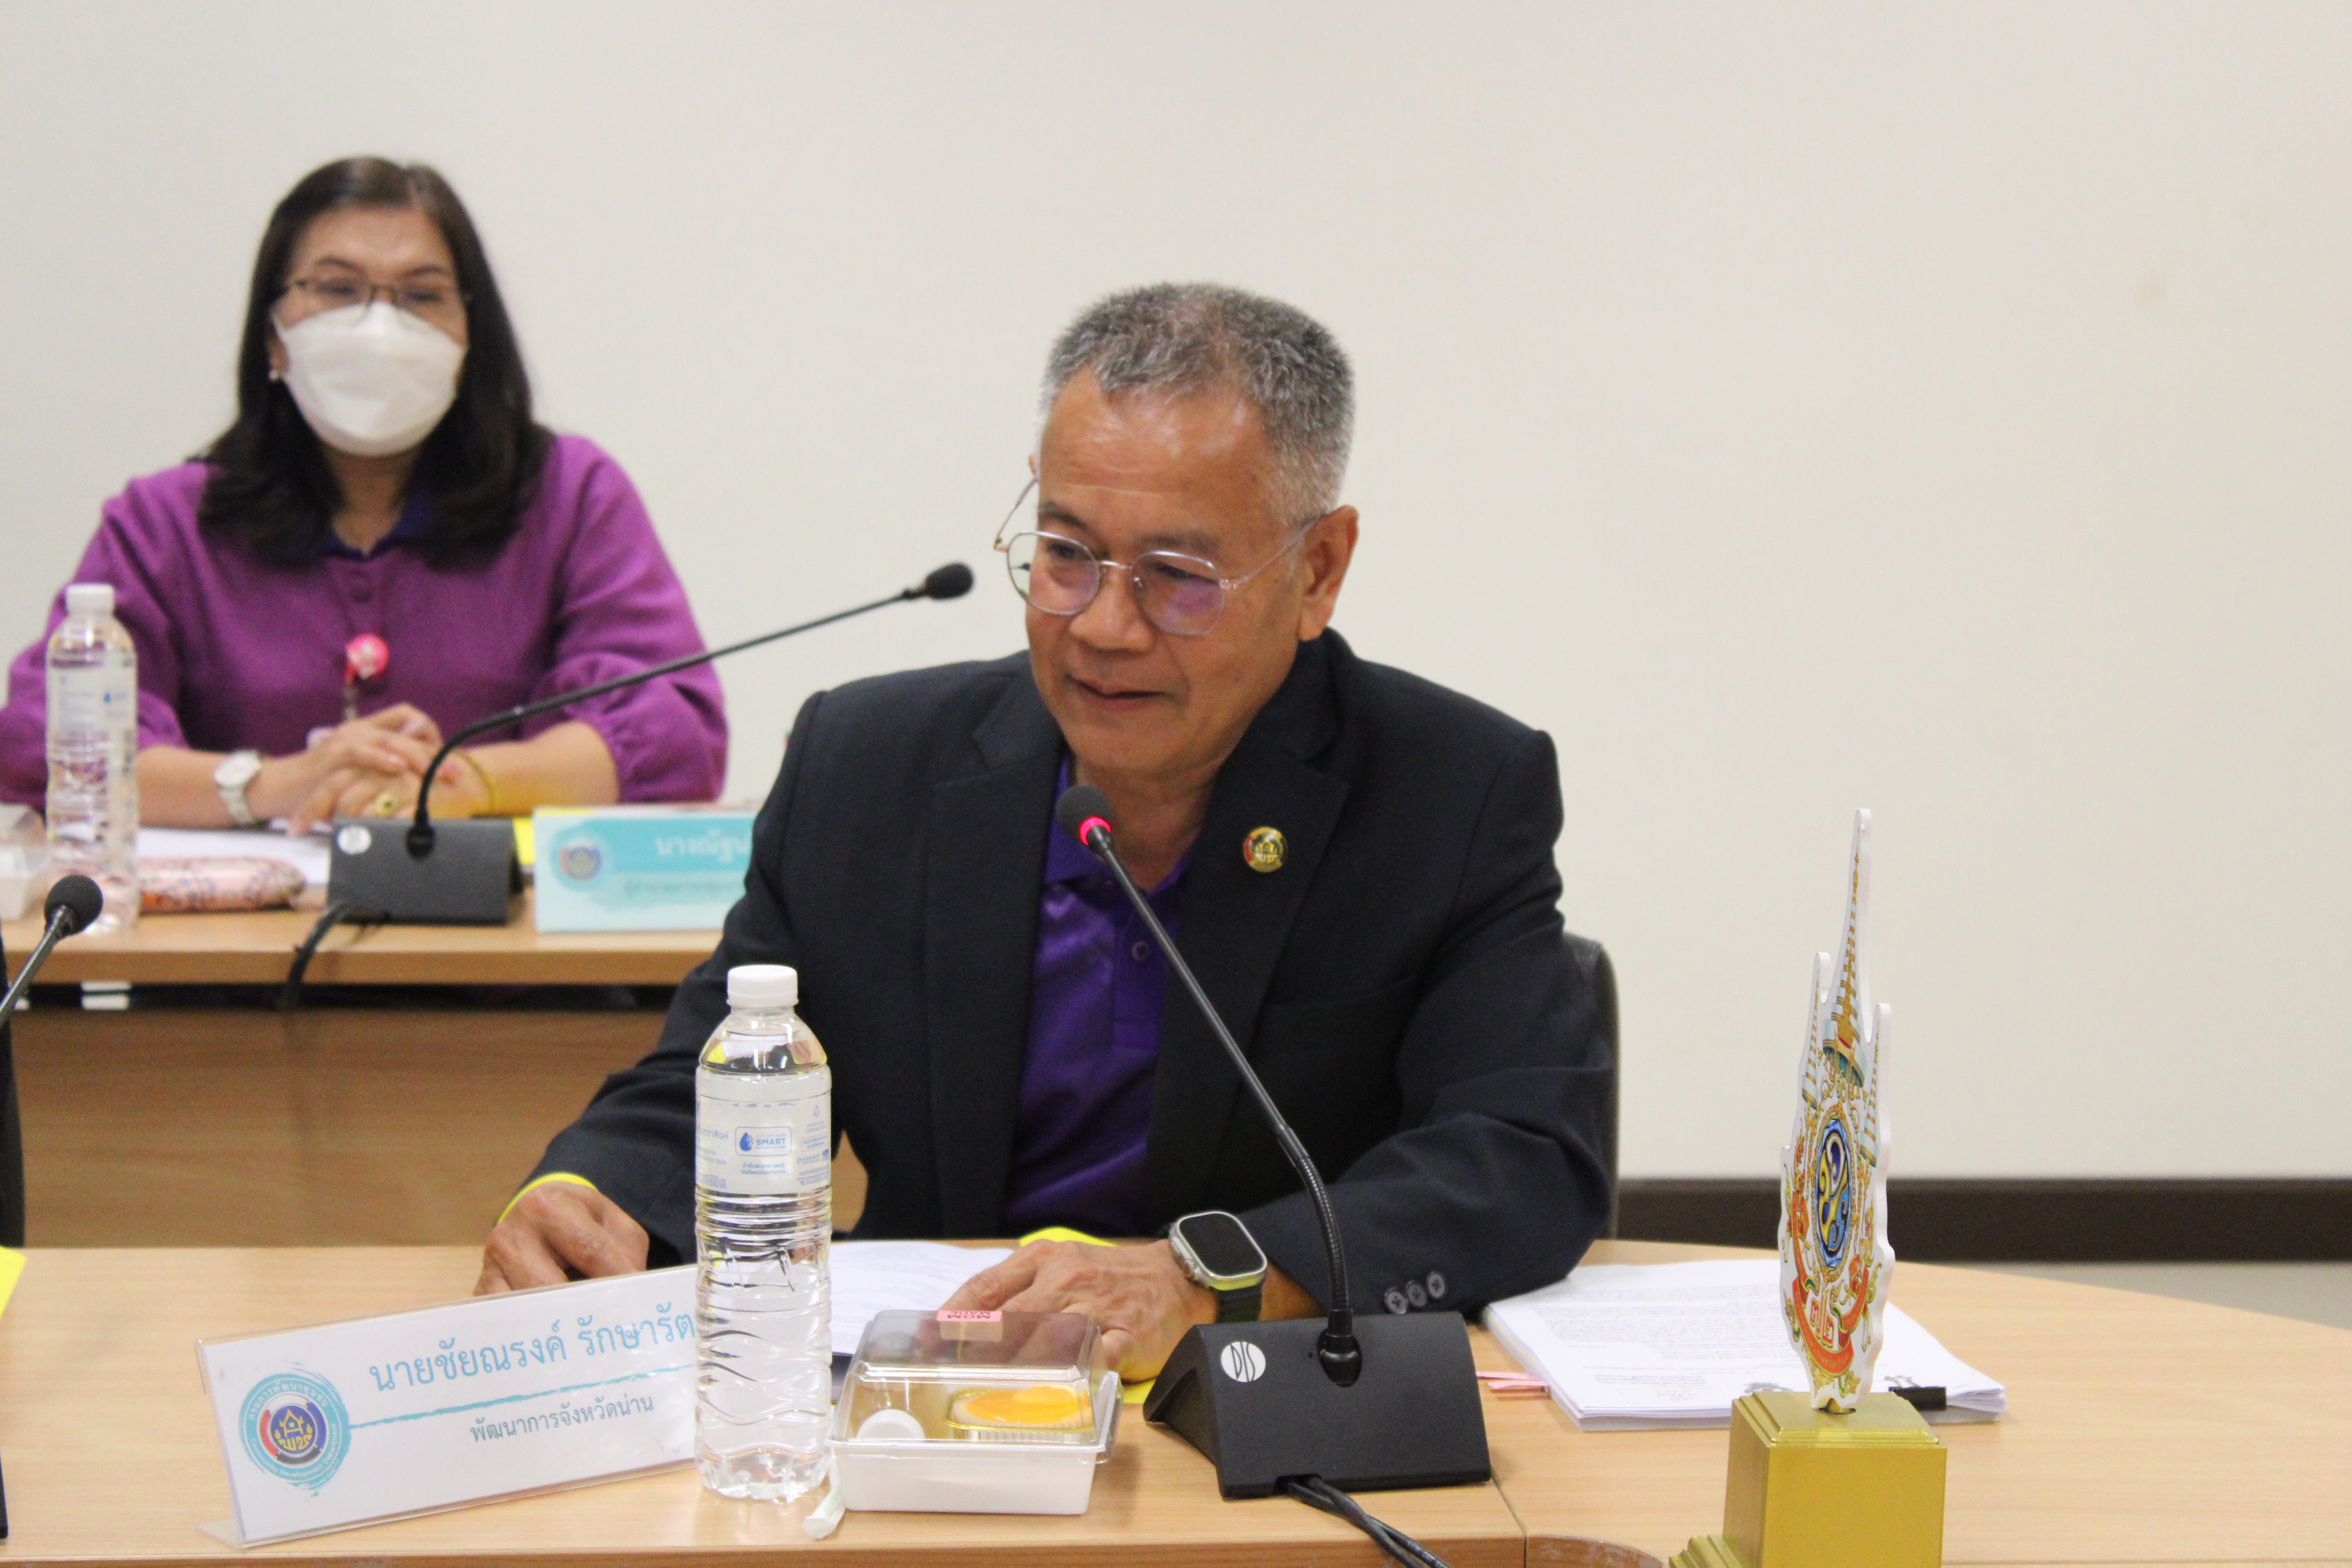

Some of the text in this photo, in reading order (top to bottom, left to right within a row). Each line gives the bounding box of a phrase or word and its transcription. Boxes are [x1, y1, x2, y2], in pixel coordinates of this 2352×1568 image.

[756, 1138, 787, 1146] SMART
[369, 1301, 696, 1391] นายชัยณรงค์ รักษารัต
[470, 1393, 655, 1442] พัฒนาการจังหวัดน่าน
[250, 1423, 338, 1478] Community Development Department
